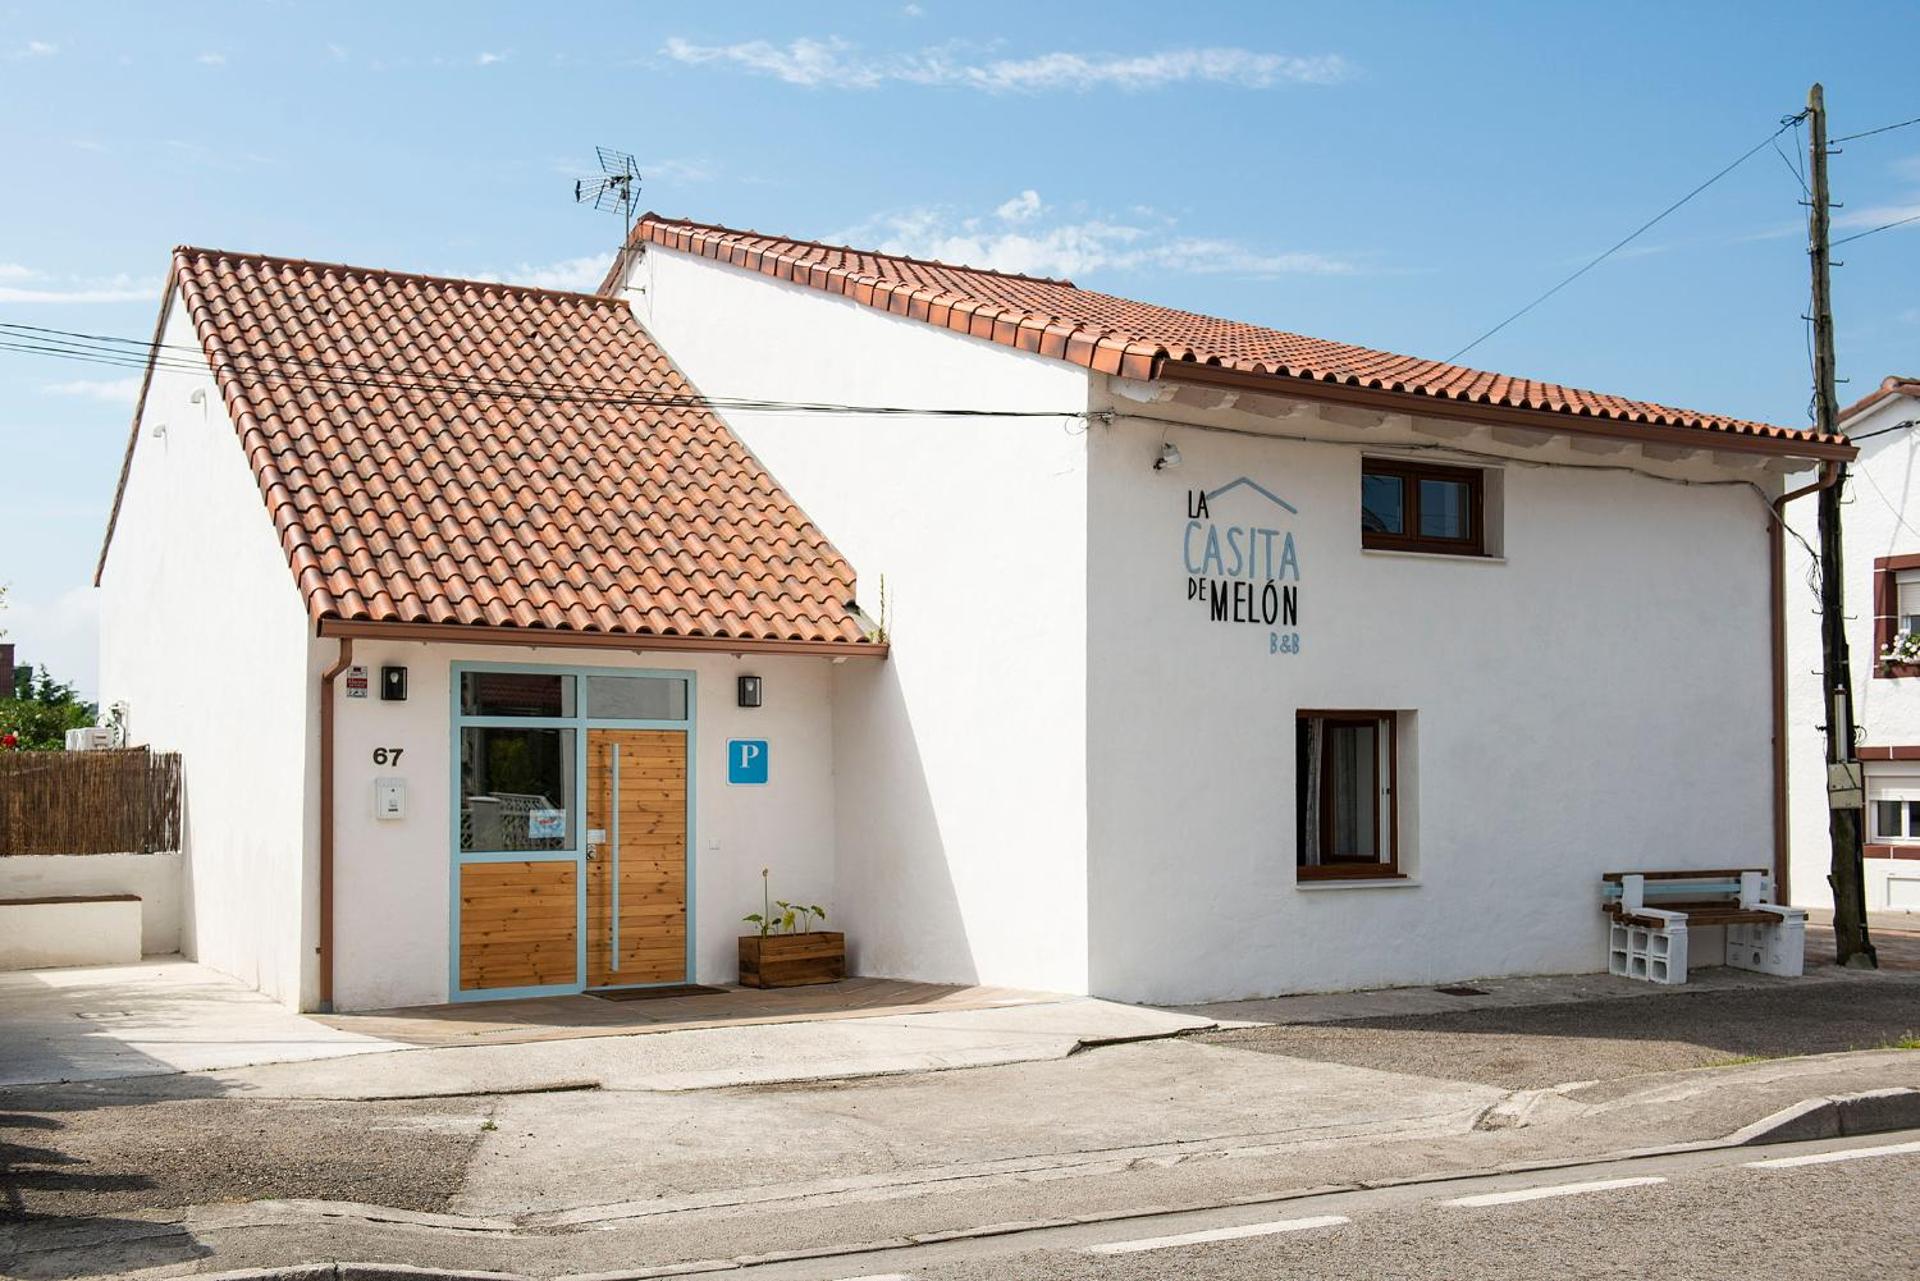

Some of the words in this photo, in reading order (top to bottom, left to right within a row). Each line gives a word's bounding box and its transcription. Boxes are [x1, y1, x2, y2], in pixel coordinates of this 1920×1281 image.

[1188, 490, 1209, 519] LA
[1183, 520, 1300, 581] CASITA
[1188, 577, 1206, 601] DE
[1210, 578, 1298, 626] MELÓN
[1269, 632, 1300, 655] B&B
[373, 747, 404, 767] 67
[739, 744, 759, 769] P
